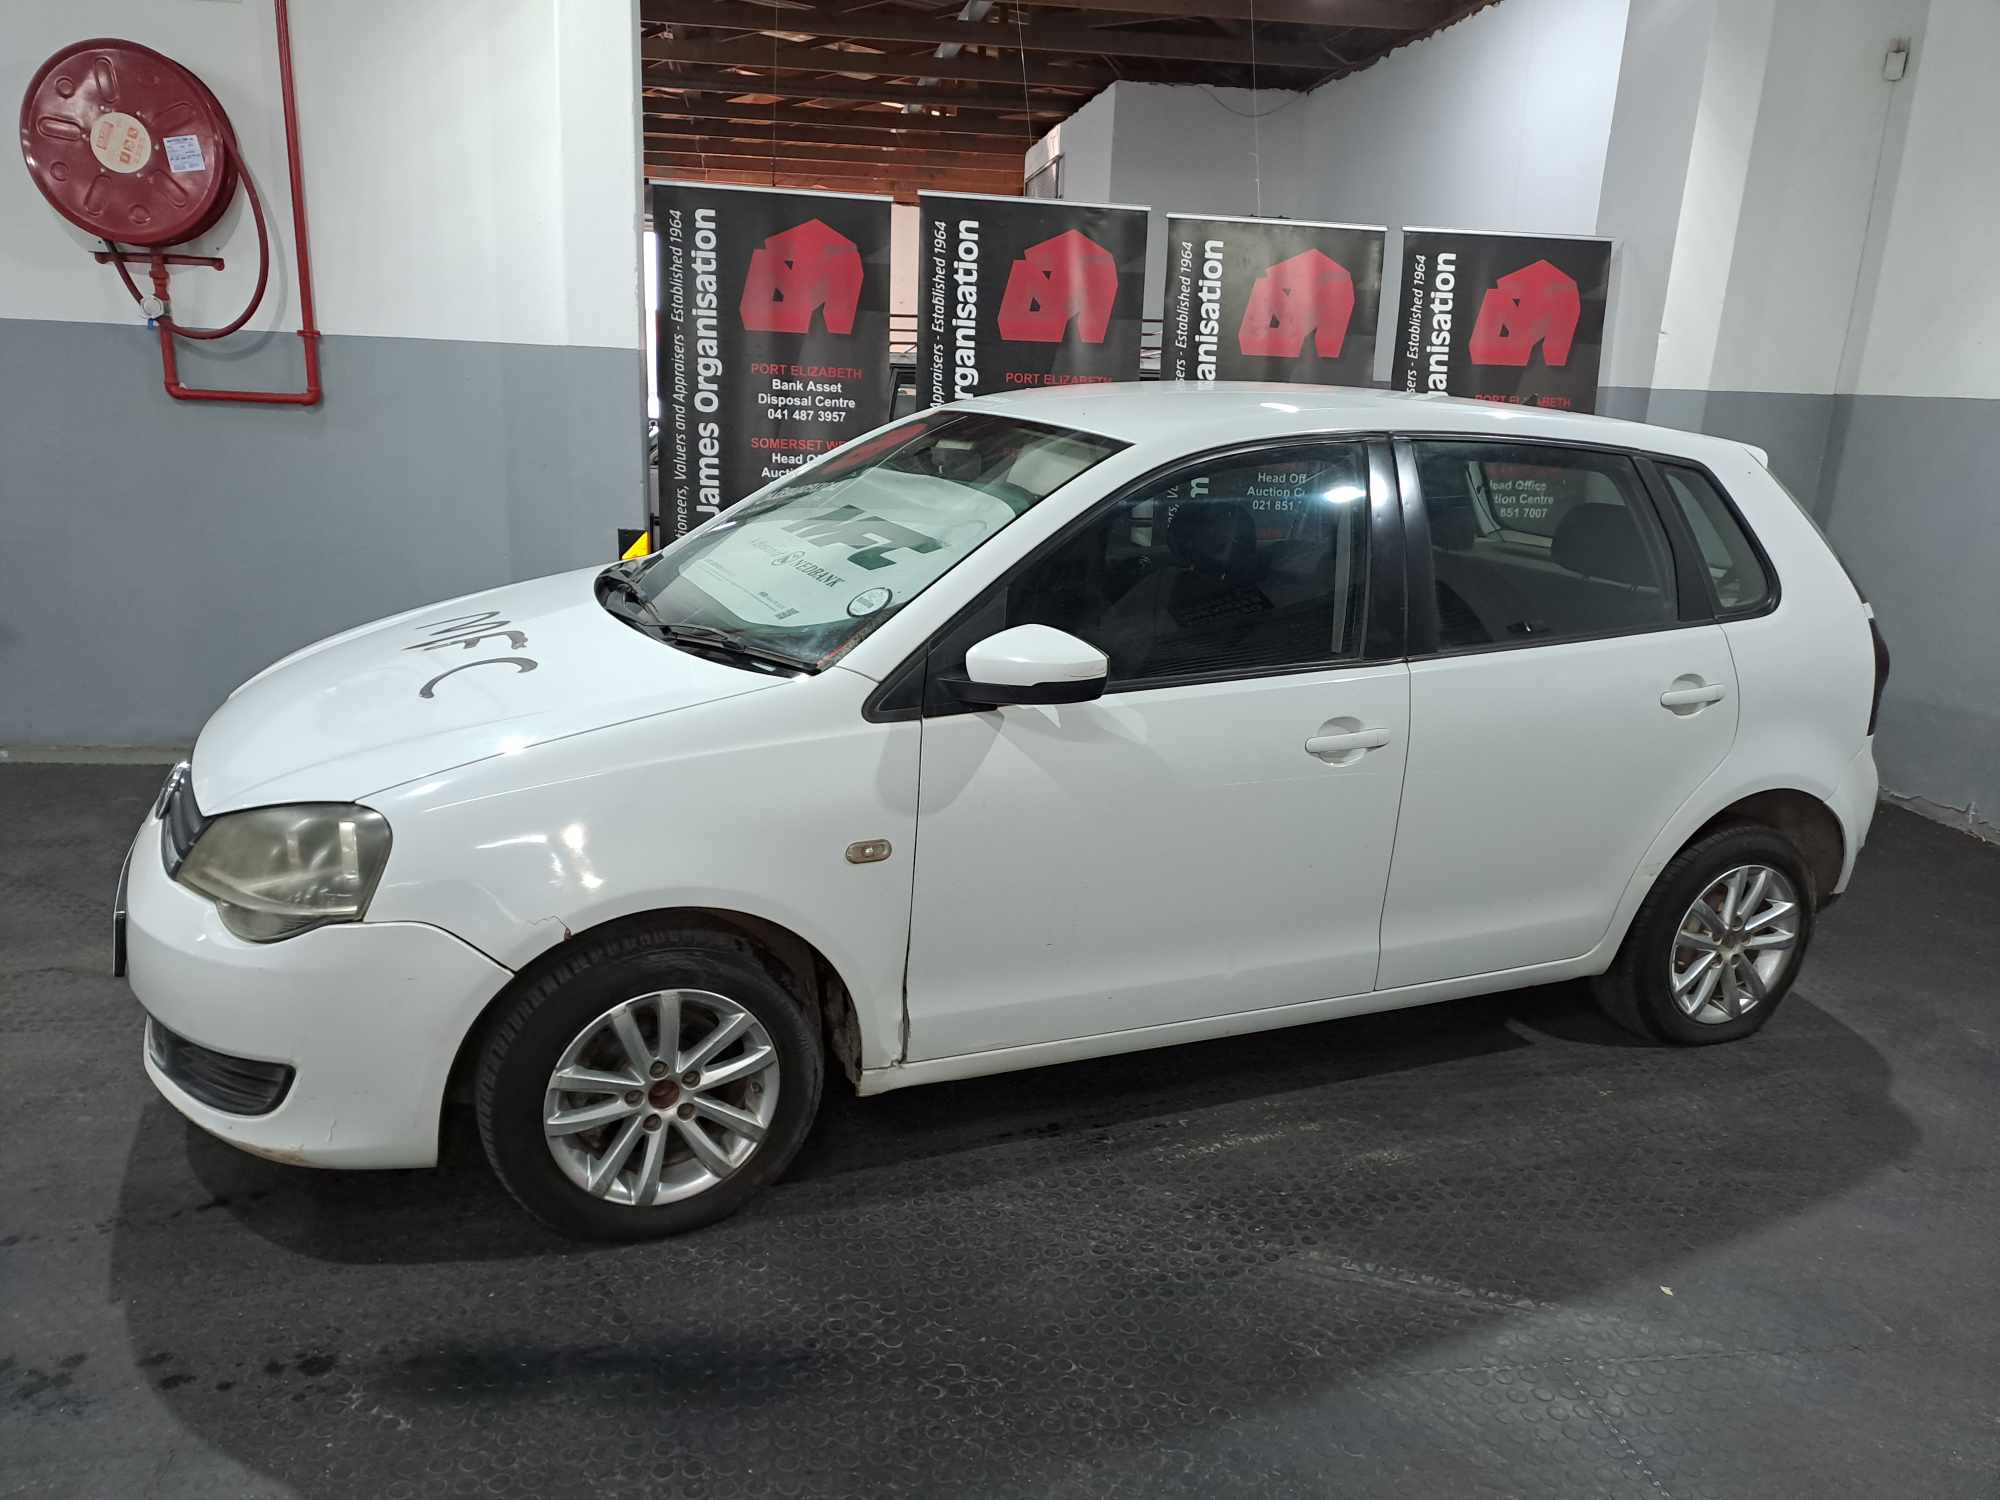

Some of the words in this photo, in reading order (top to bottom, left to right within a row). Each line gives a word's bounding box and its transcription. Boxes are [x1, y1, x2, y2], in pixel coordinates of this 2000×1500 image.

[669, 209, 683, 244] 1964
[934, 220, 947, 253] 1964
[1181, 241, 1193, 272] 1964
[1413, 254, 1426, 284] 1964
[669, 247, 684, 323] Established
[931, 254, 946, 333] Established
[691, 209, 722, 413] Organisation
[1175, 275, 1191, 349] Established
[1406, 287, 1424, 360] Established
[1426, 252, 1457, 396] anisation
[671, 333, 688, 402] Appraisers
[751, 363, 788, 375] PORT
[790, 365, 863, 379] ELIZABETH
[1005, 372, 1040, 384] PORT
[758, 393, 812, 407] Disposal
[815, 396, 856, 409] Centre
[771, 379, 804, 391] Bank
[806, 381, 842, 393] Asset
[672, 404, 686, 429] and
[767, 408, 788, 420] 041
[792, 410, 814, 421] 487
[817, 411, 847, 423] 3957
[673, 434, 687, 480] Valuers
[751, 438, 823, 450] SOMERSET
[771, 452, 803, 465] Head
[696, 422, 720, 515] James
[1258, 471, 1286, 484] Head
[1247, 486, 1290, 497] Auction
